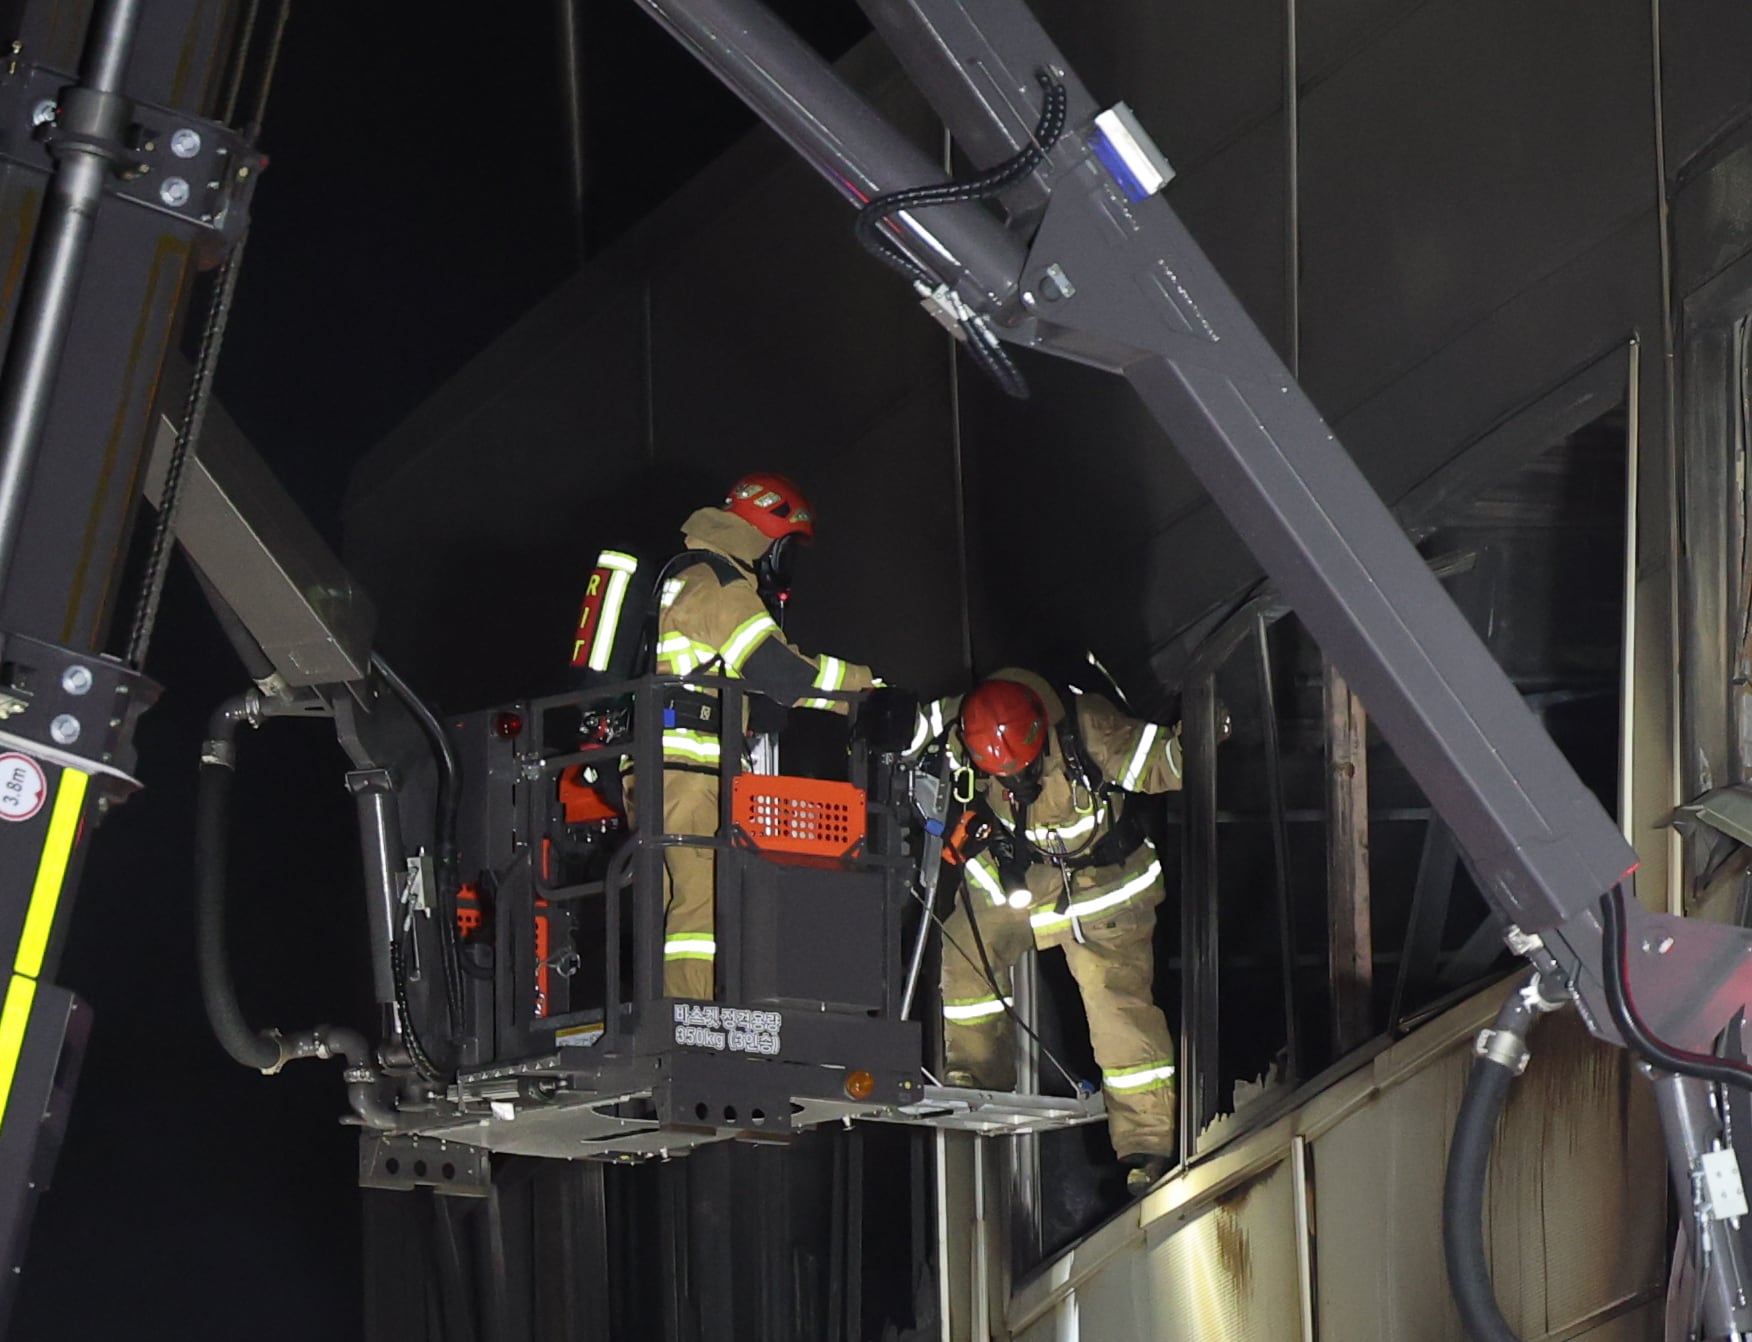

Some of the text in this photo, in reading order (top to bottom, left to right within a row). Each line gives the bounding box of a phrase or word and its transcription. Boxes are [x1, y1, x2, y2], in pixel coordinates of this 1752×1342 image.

[572, 574, 600, 661] RIT
[3, 768, 26, 806] 3.8m
[674, 1005, 781, 1032] 바스켓 정격용량
[675, 1025, 780, 1054] 350kg (3인승)
